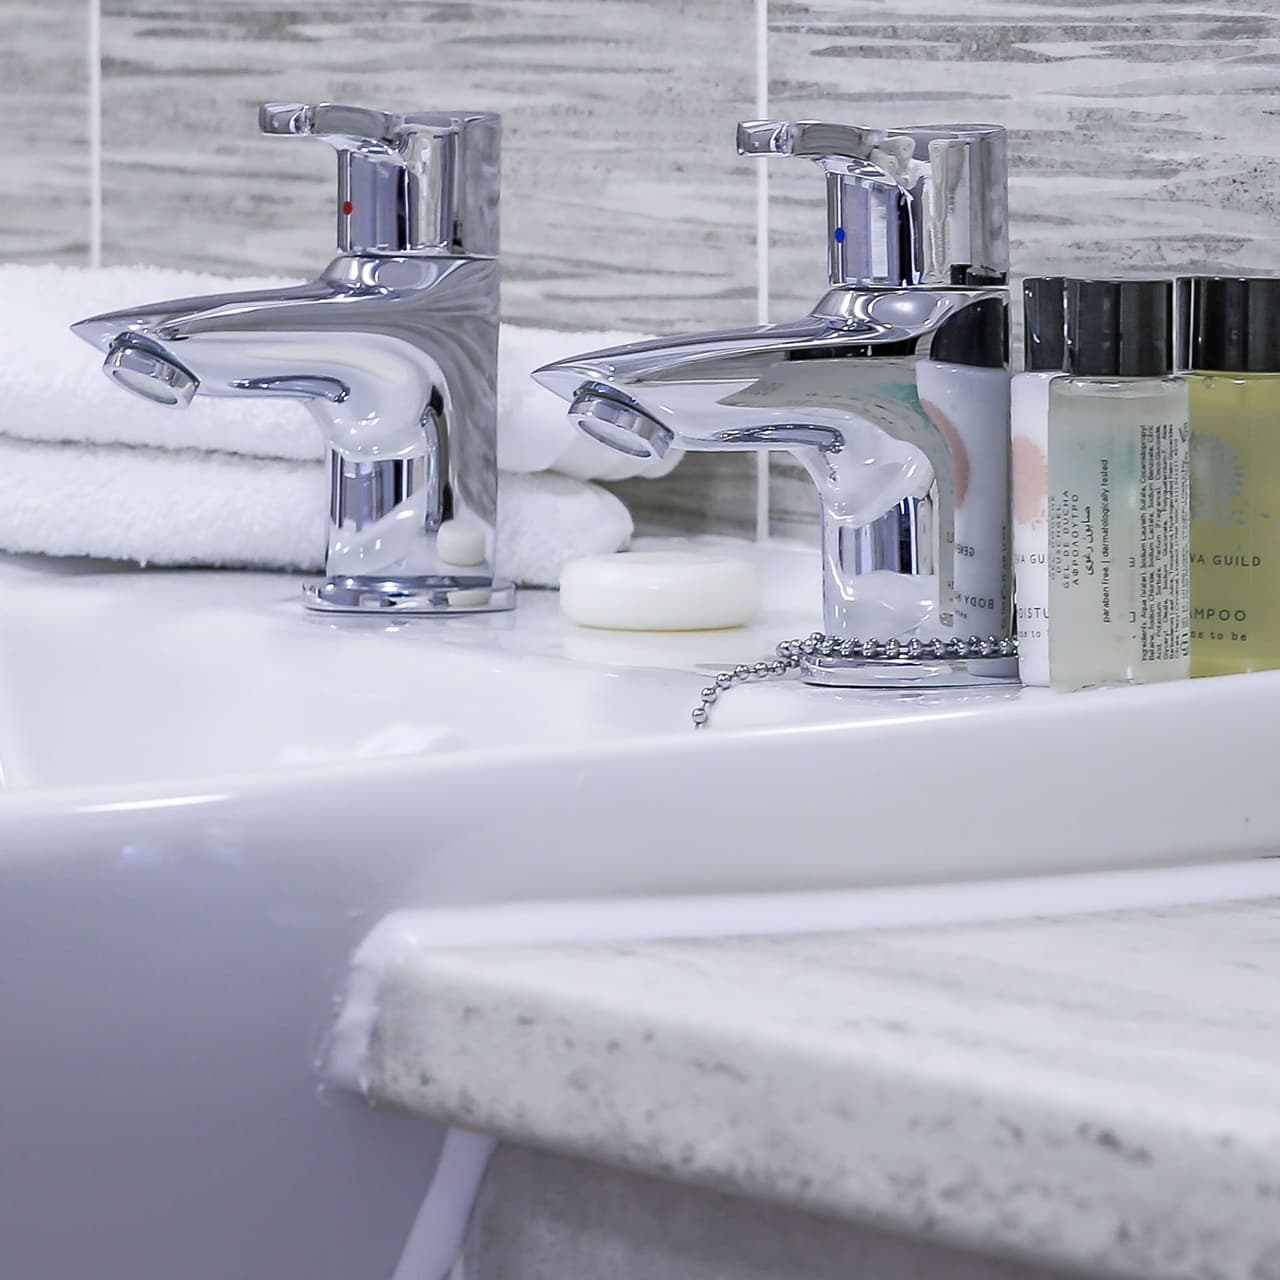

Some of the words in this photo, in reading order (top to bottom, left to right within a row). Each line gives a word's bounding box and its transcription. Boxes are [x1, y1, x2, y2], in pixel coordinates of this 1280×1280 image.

[1099, 459, 1108, 486] tested
[1100, 489, 1111, 558] dermatologically
[1063, 543, 1070, 557] DE
[1213, 555, 1261, 567] GUILD
[1101, 567, 1109, 585] free
[1102, 587, 1111, 623] paraben
[1211, 631, 1224, 640] to
[1231, 631, 1248, 641] be
